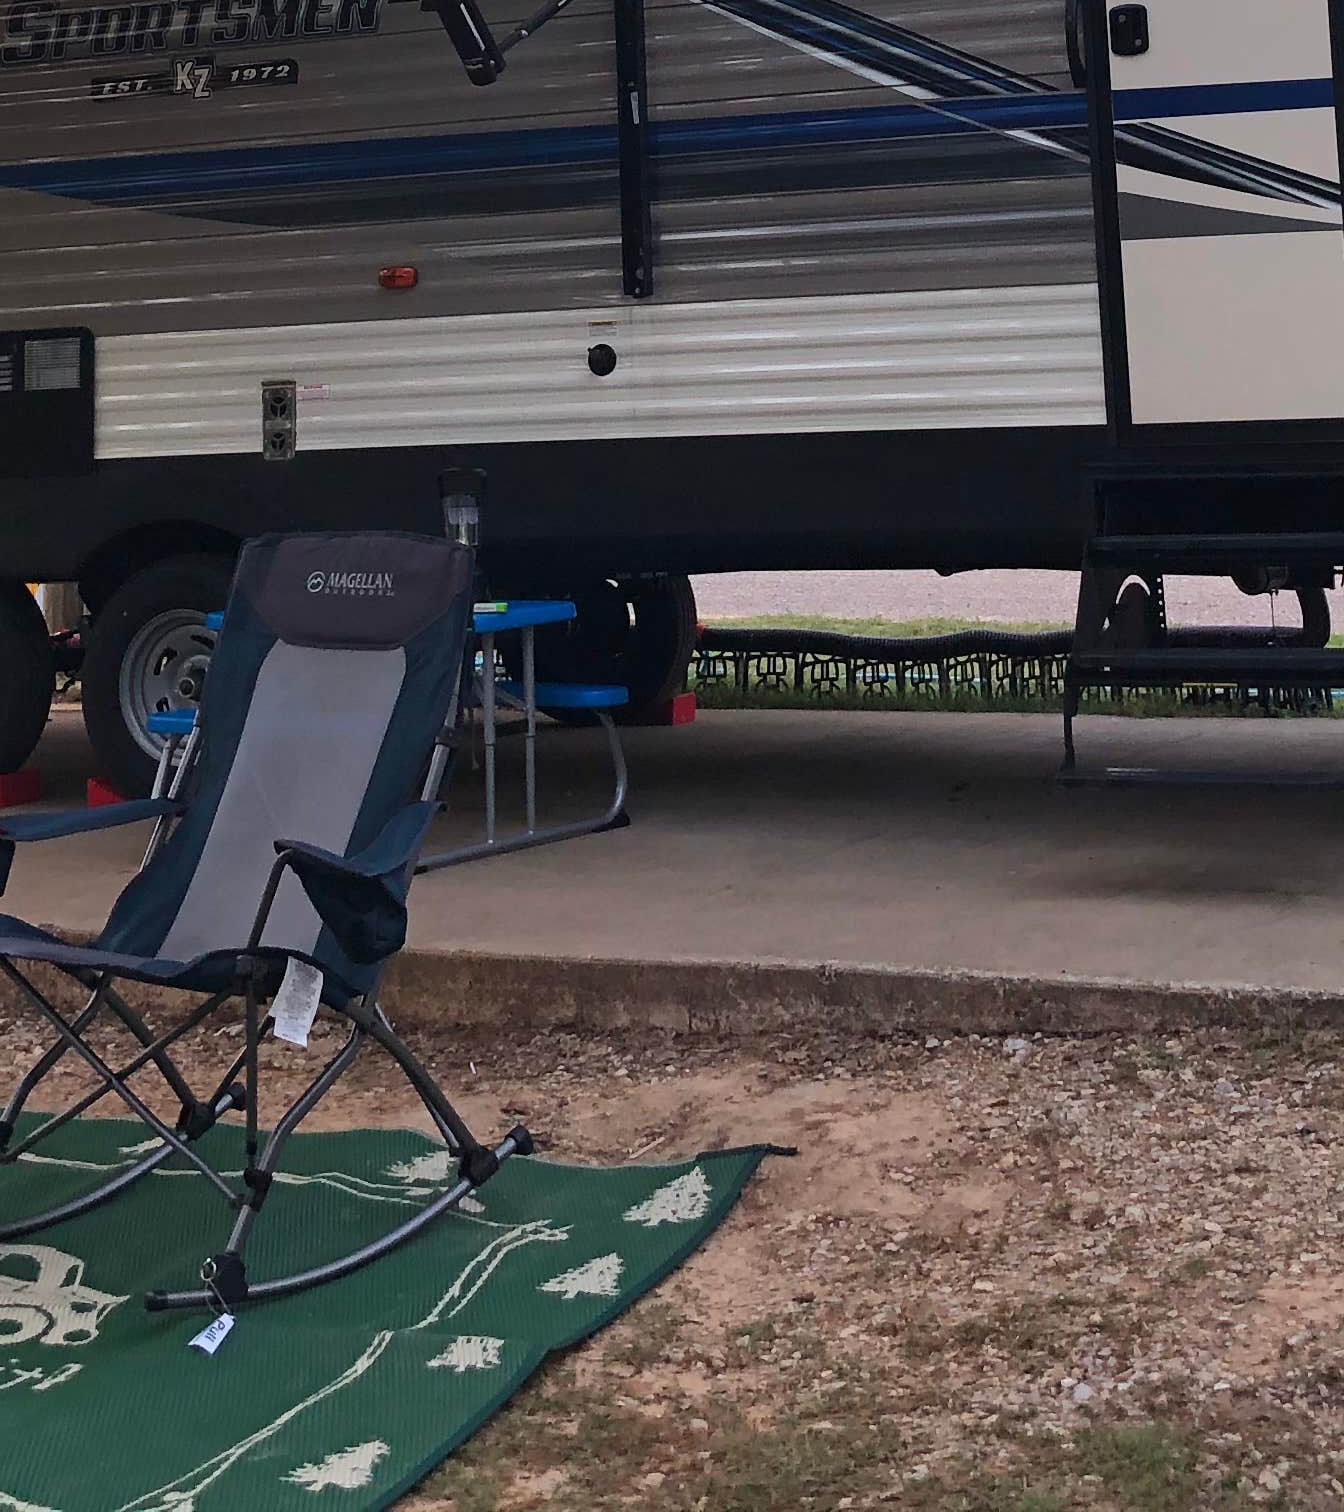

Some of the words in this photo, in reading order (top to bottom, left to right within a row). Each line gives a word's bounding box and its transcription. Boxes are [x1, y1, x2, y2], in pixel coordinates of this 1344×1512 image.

[175, 60, 212, 99] KZ
[230, 64, 291, 82] 1972
[326, 572, 393, 589] MAGELLAN
[204, 1319, 226, 1343] Pull
